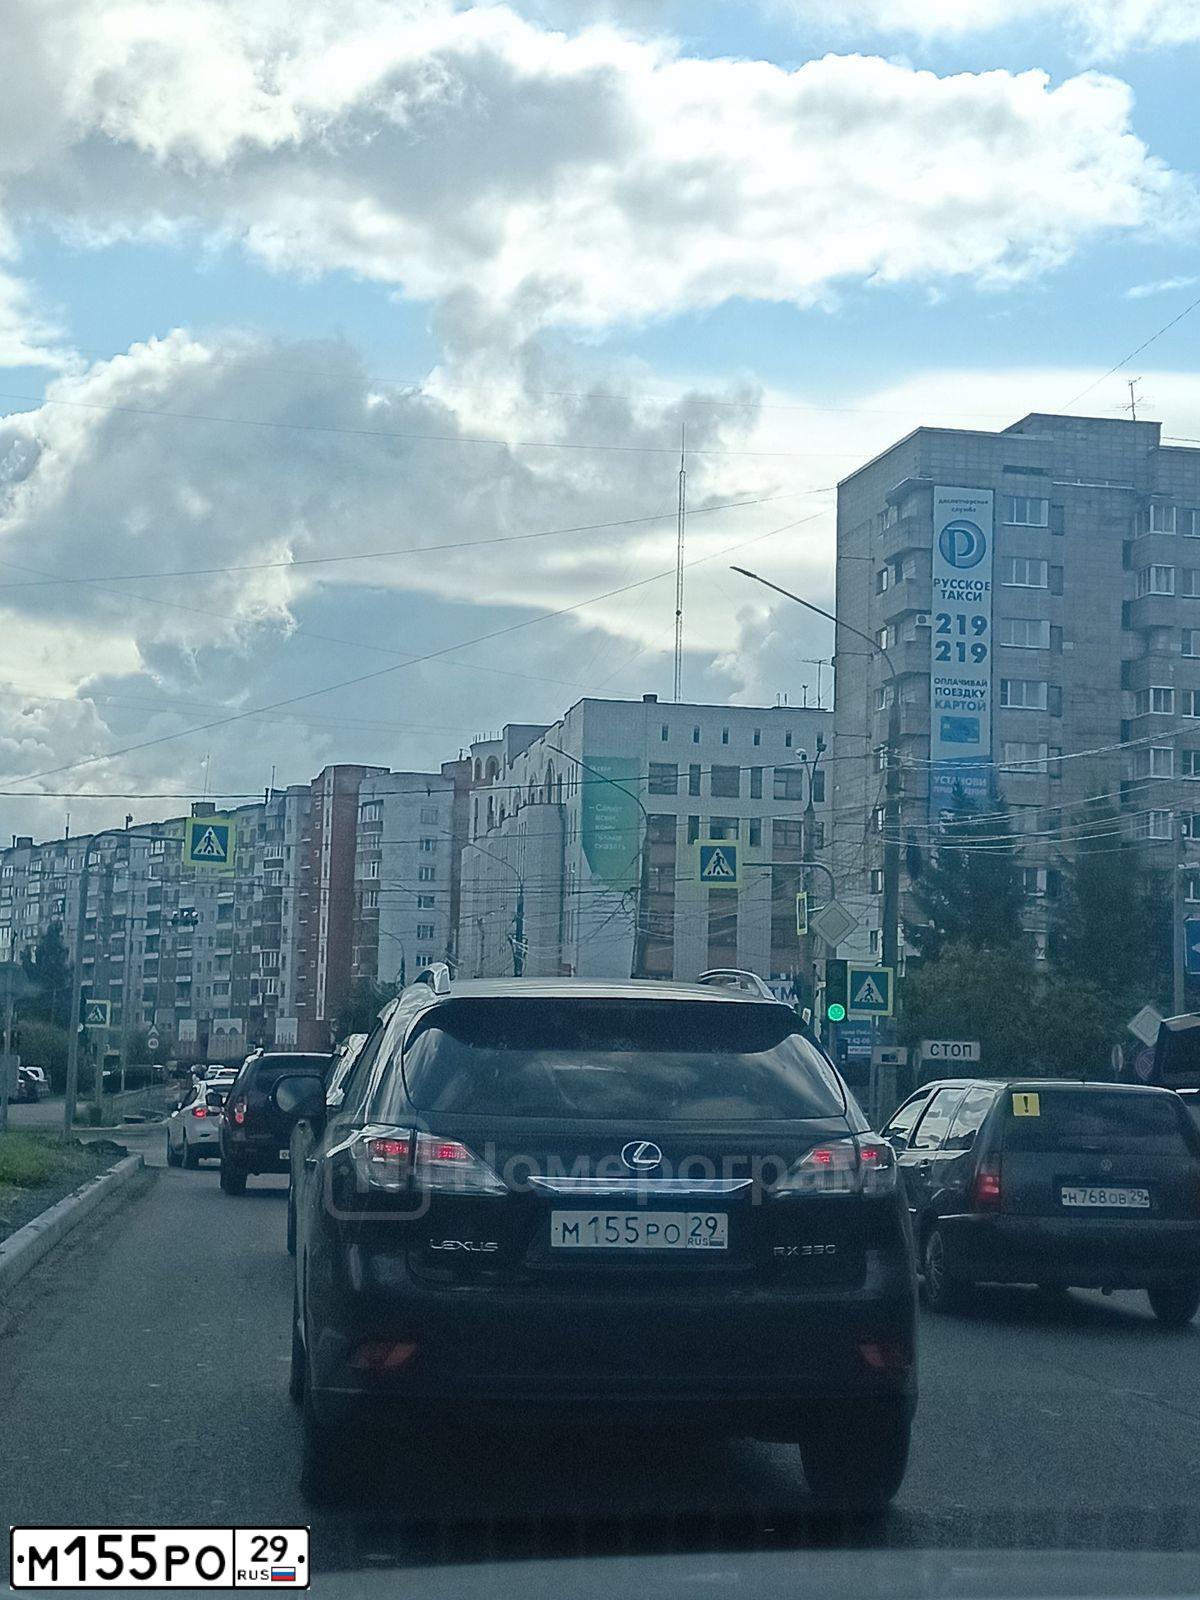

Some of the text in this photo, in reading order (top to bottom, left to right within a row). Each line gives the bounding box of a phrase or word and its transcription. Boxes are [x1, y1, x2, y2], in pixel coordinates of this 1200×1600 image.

[934, 578, 991, 591] РУССКОЕ
[941, 590, 983, 602] ТАКСИ
[935, 612, 988, 636] 219
[935, 640, 988, 664] 219
[934, 677, 988, 688] ОПЛАЧИВАЙ
[934, 686, 986, 699] ПОЕЗДКУ
[934, 700, 987, 712] КАРТОЙ
[930, 1043, 972, 1058] СТОП
[1130, 1190, 1144, 1202] 29
[691, 1217, 718, 1238] 29
[430, 1239, 499, 1252] LEXUS
[688, 1238, 709, 1247] RUS
